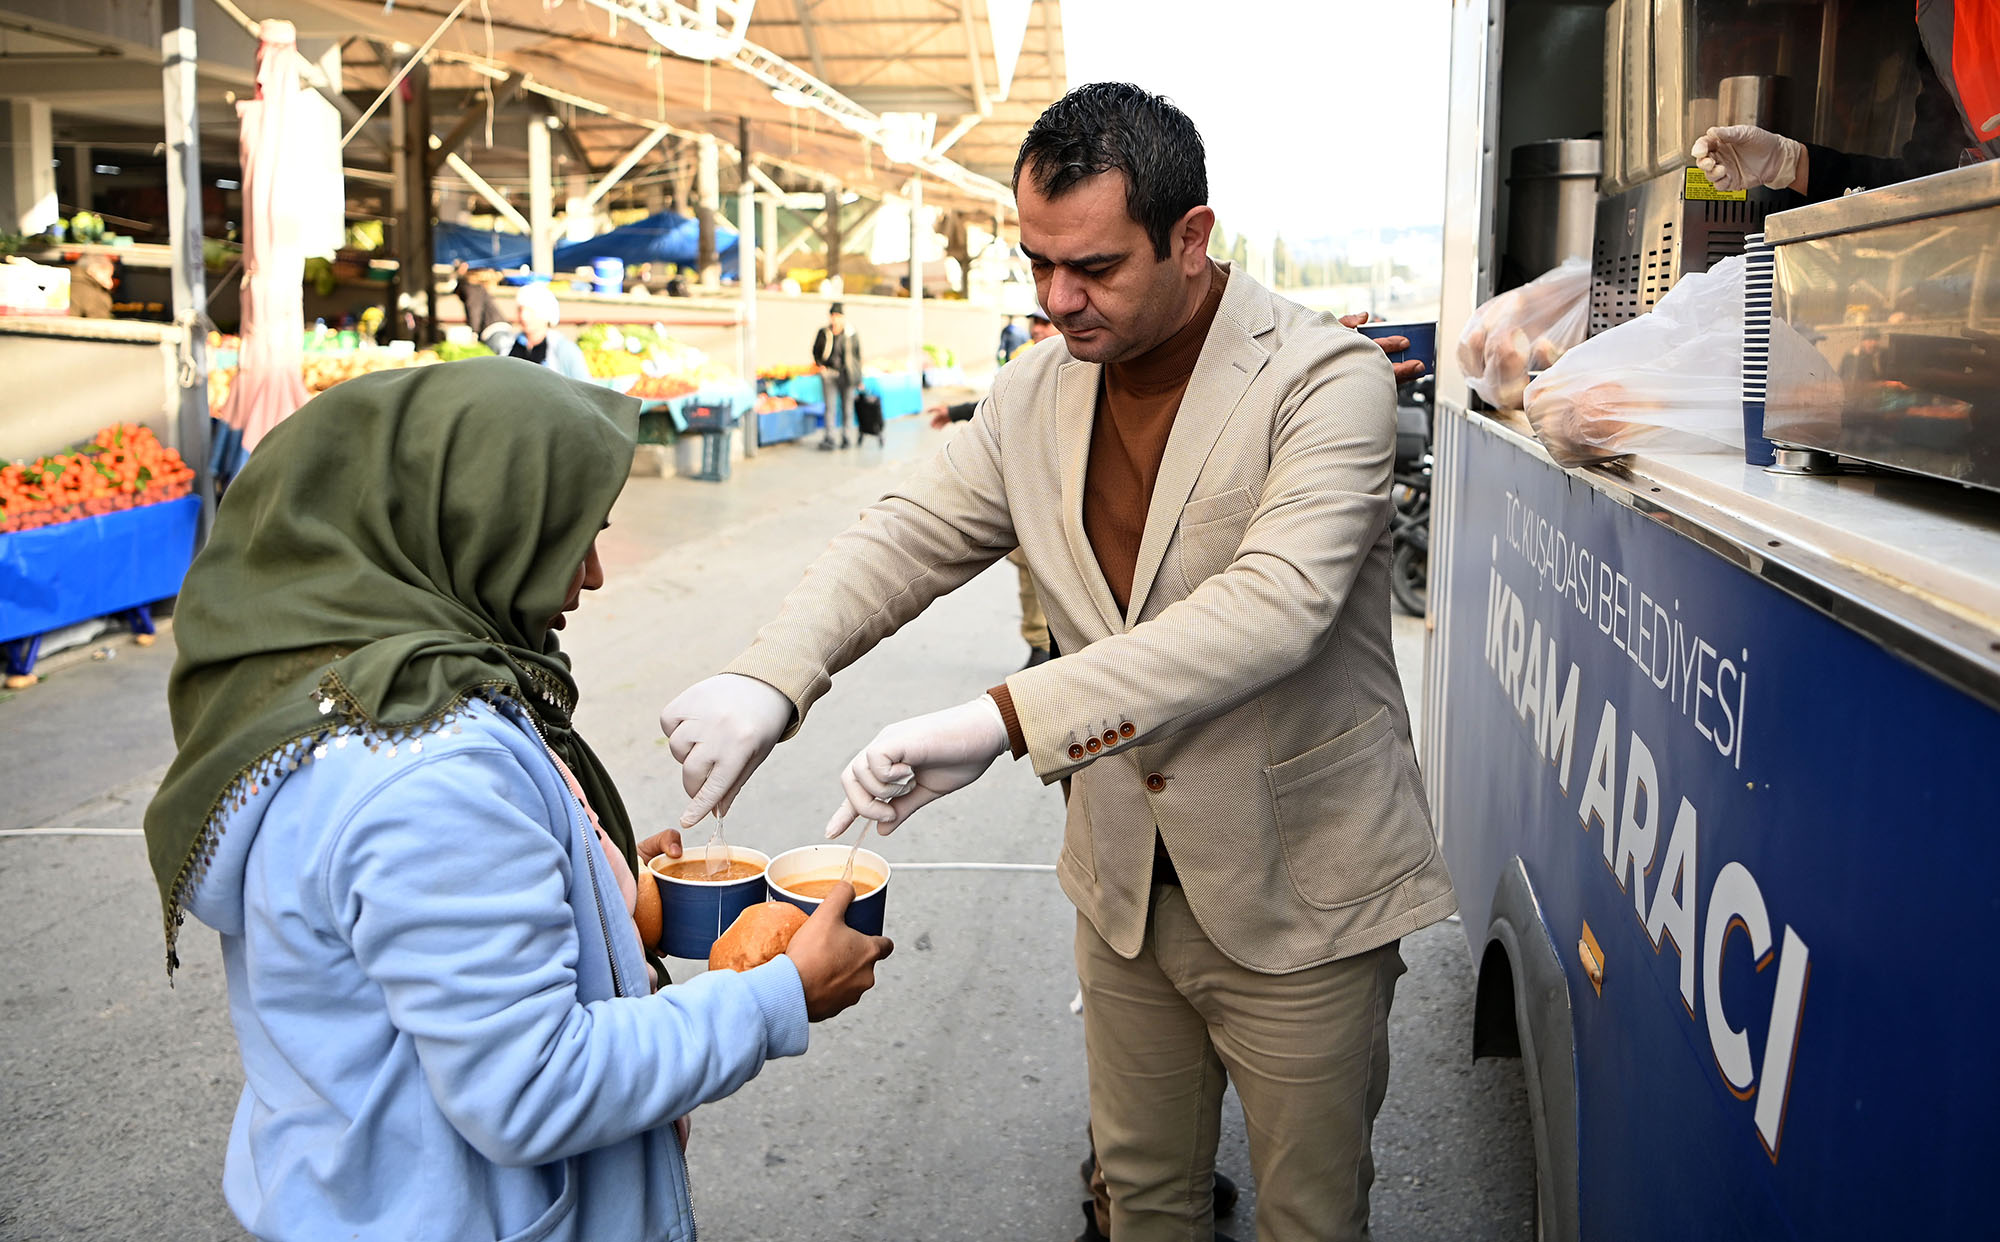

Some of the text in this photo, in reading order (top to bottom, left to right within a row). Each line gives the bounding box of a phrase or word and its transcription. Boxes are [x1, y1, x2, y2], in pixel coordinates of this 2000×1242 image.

[1485, 533, 1810, 1158] İKRAM ARACI
[1506, 491, 1749, 770] T.C. KUŞADASI BELEDİYESİ
